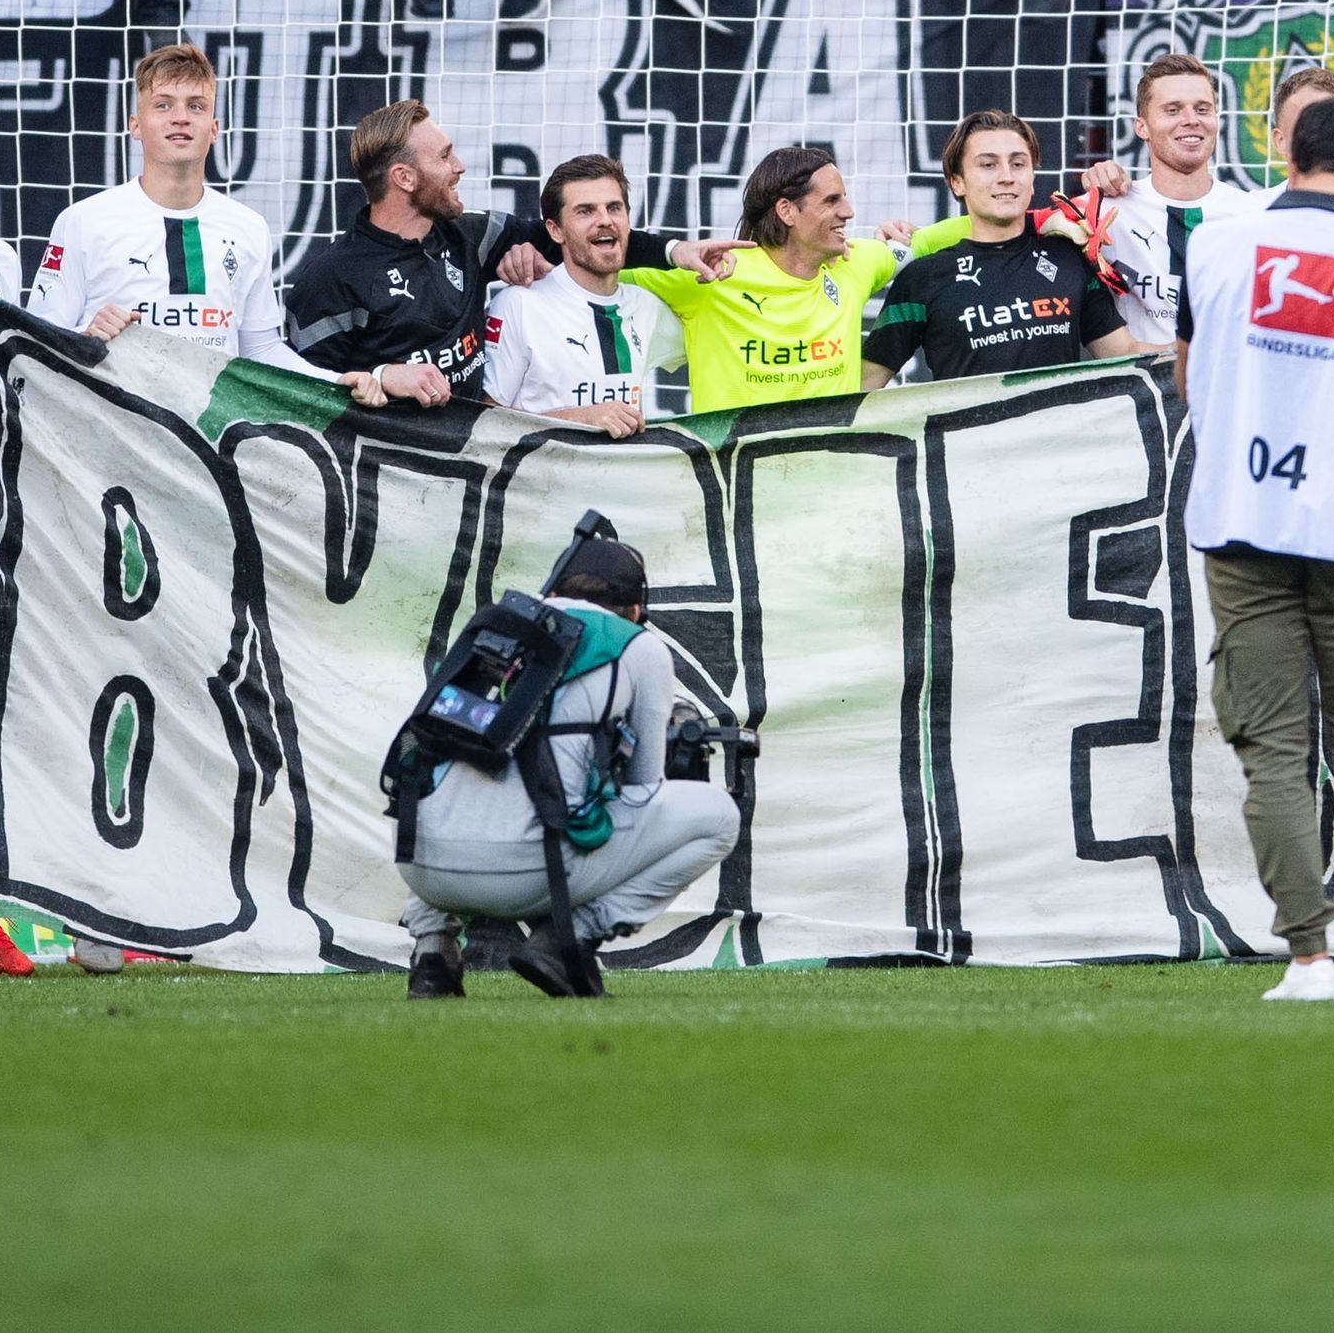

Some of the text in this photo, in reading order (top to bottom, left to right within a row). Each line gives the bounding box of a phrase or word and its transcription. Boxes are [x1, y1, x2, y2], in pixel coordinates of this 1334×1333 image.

[1136, 275, 1179, 306] fla
[970, 332, 1008, 351] Invest
[1011, 329, 1025, 344] in
[745, 363, 846, 386] Invest in yourself
[1246, 436, 1307, 492] 04
